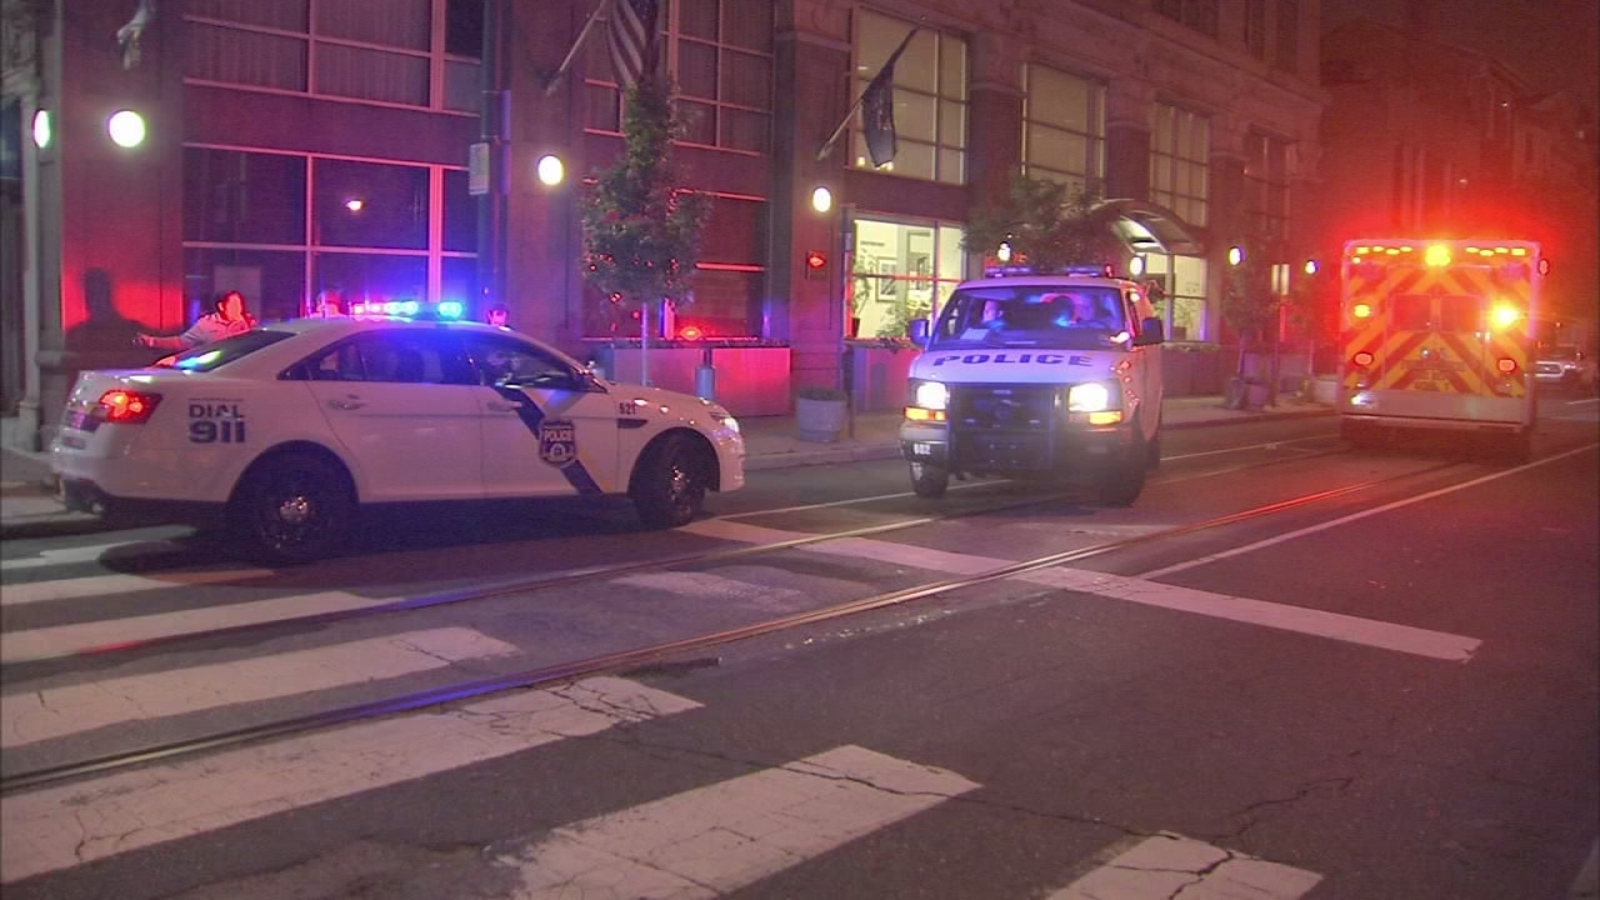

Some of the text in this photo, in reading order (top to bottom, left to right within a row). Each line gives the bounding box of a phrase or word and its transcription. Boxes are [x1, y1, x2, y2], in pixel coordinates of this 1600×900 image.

[933, 354, 1094, 367] POLICE
[189, 403, 245, 418] DIAL
[189, 420, 245, 443] 911
[544, 429, 572, 441] POLICE
